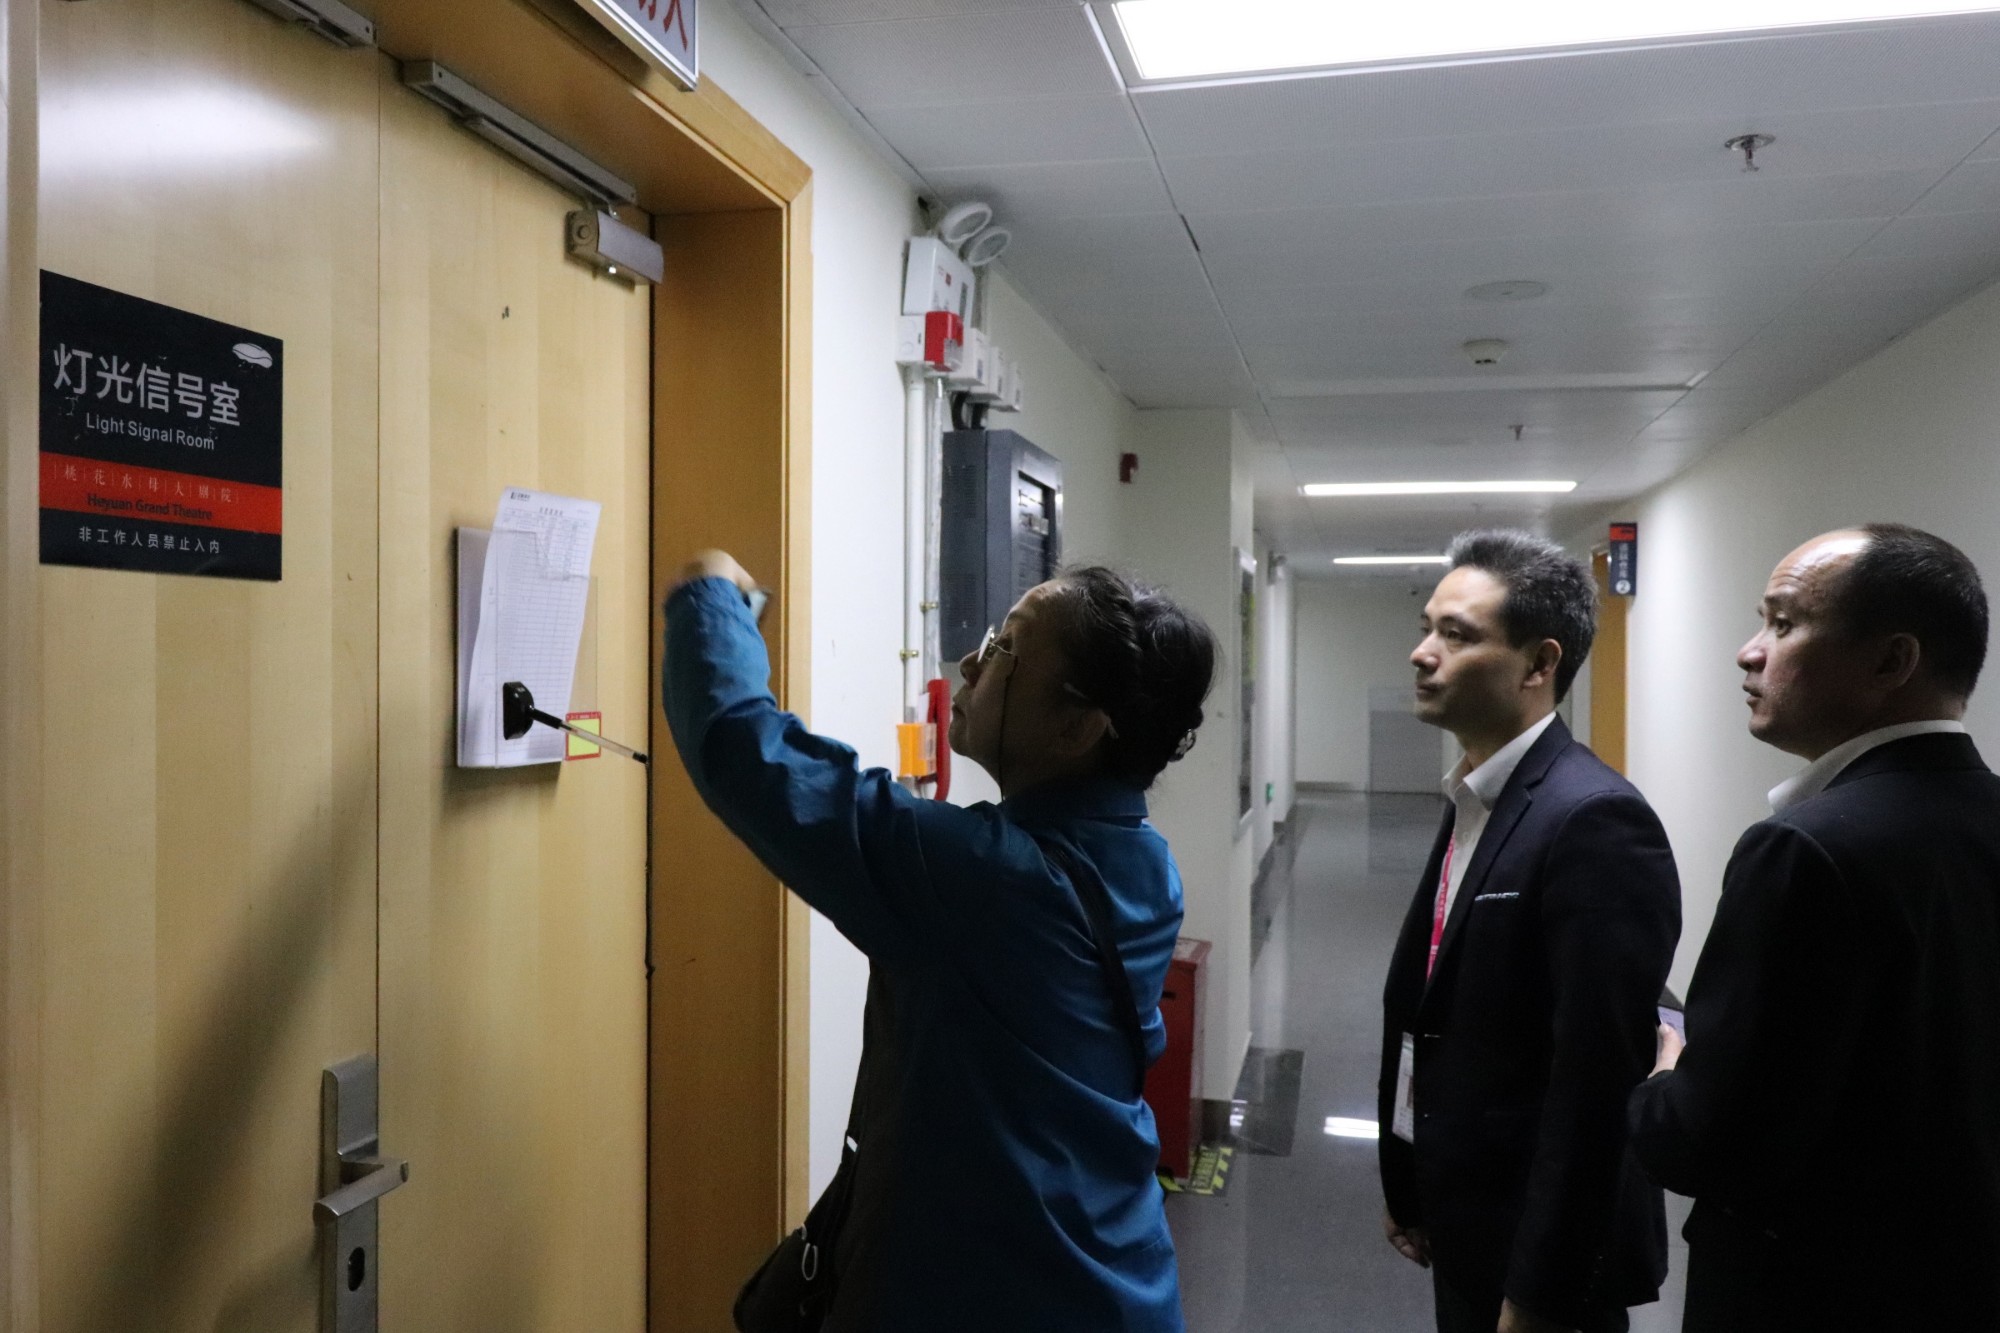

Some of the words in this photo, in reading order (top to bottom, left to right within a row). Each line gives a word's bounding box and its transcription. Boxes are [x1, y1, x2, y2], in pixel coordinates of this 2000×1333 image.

[53, 343, 240, 426] 灯光信号室
[86, 412, 124, 434] Light
[128, 420, 173, 443] Signal
[176, 429, 215, 450] Room
[87, 492, 132, 513] Heyuan
[135, 499, 169, 516] Grand
[172, 503, 213, 520] Theatre
[79, 526, 220, 554] 非工作人员禁止入内
